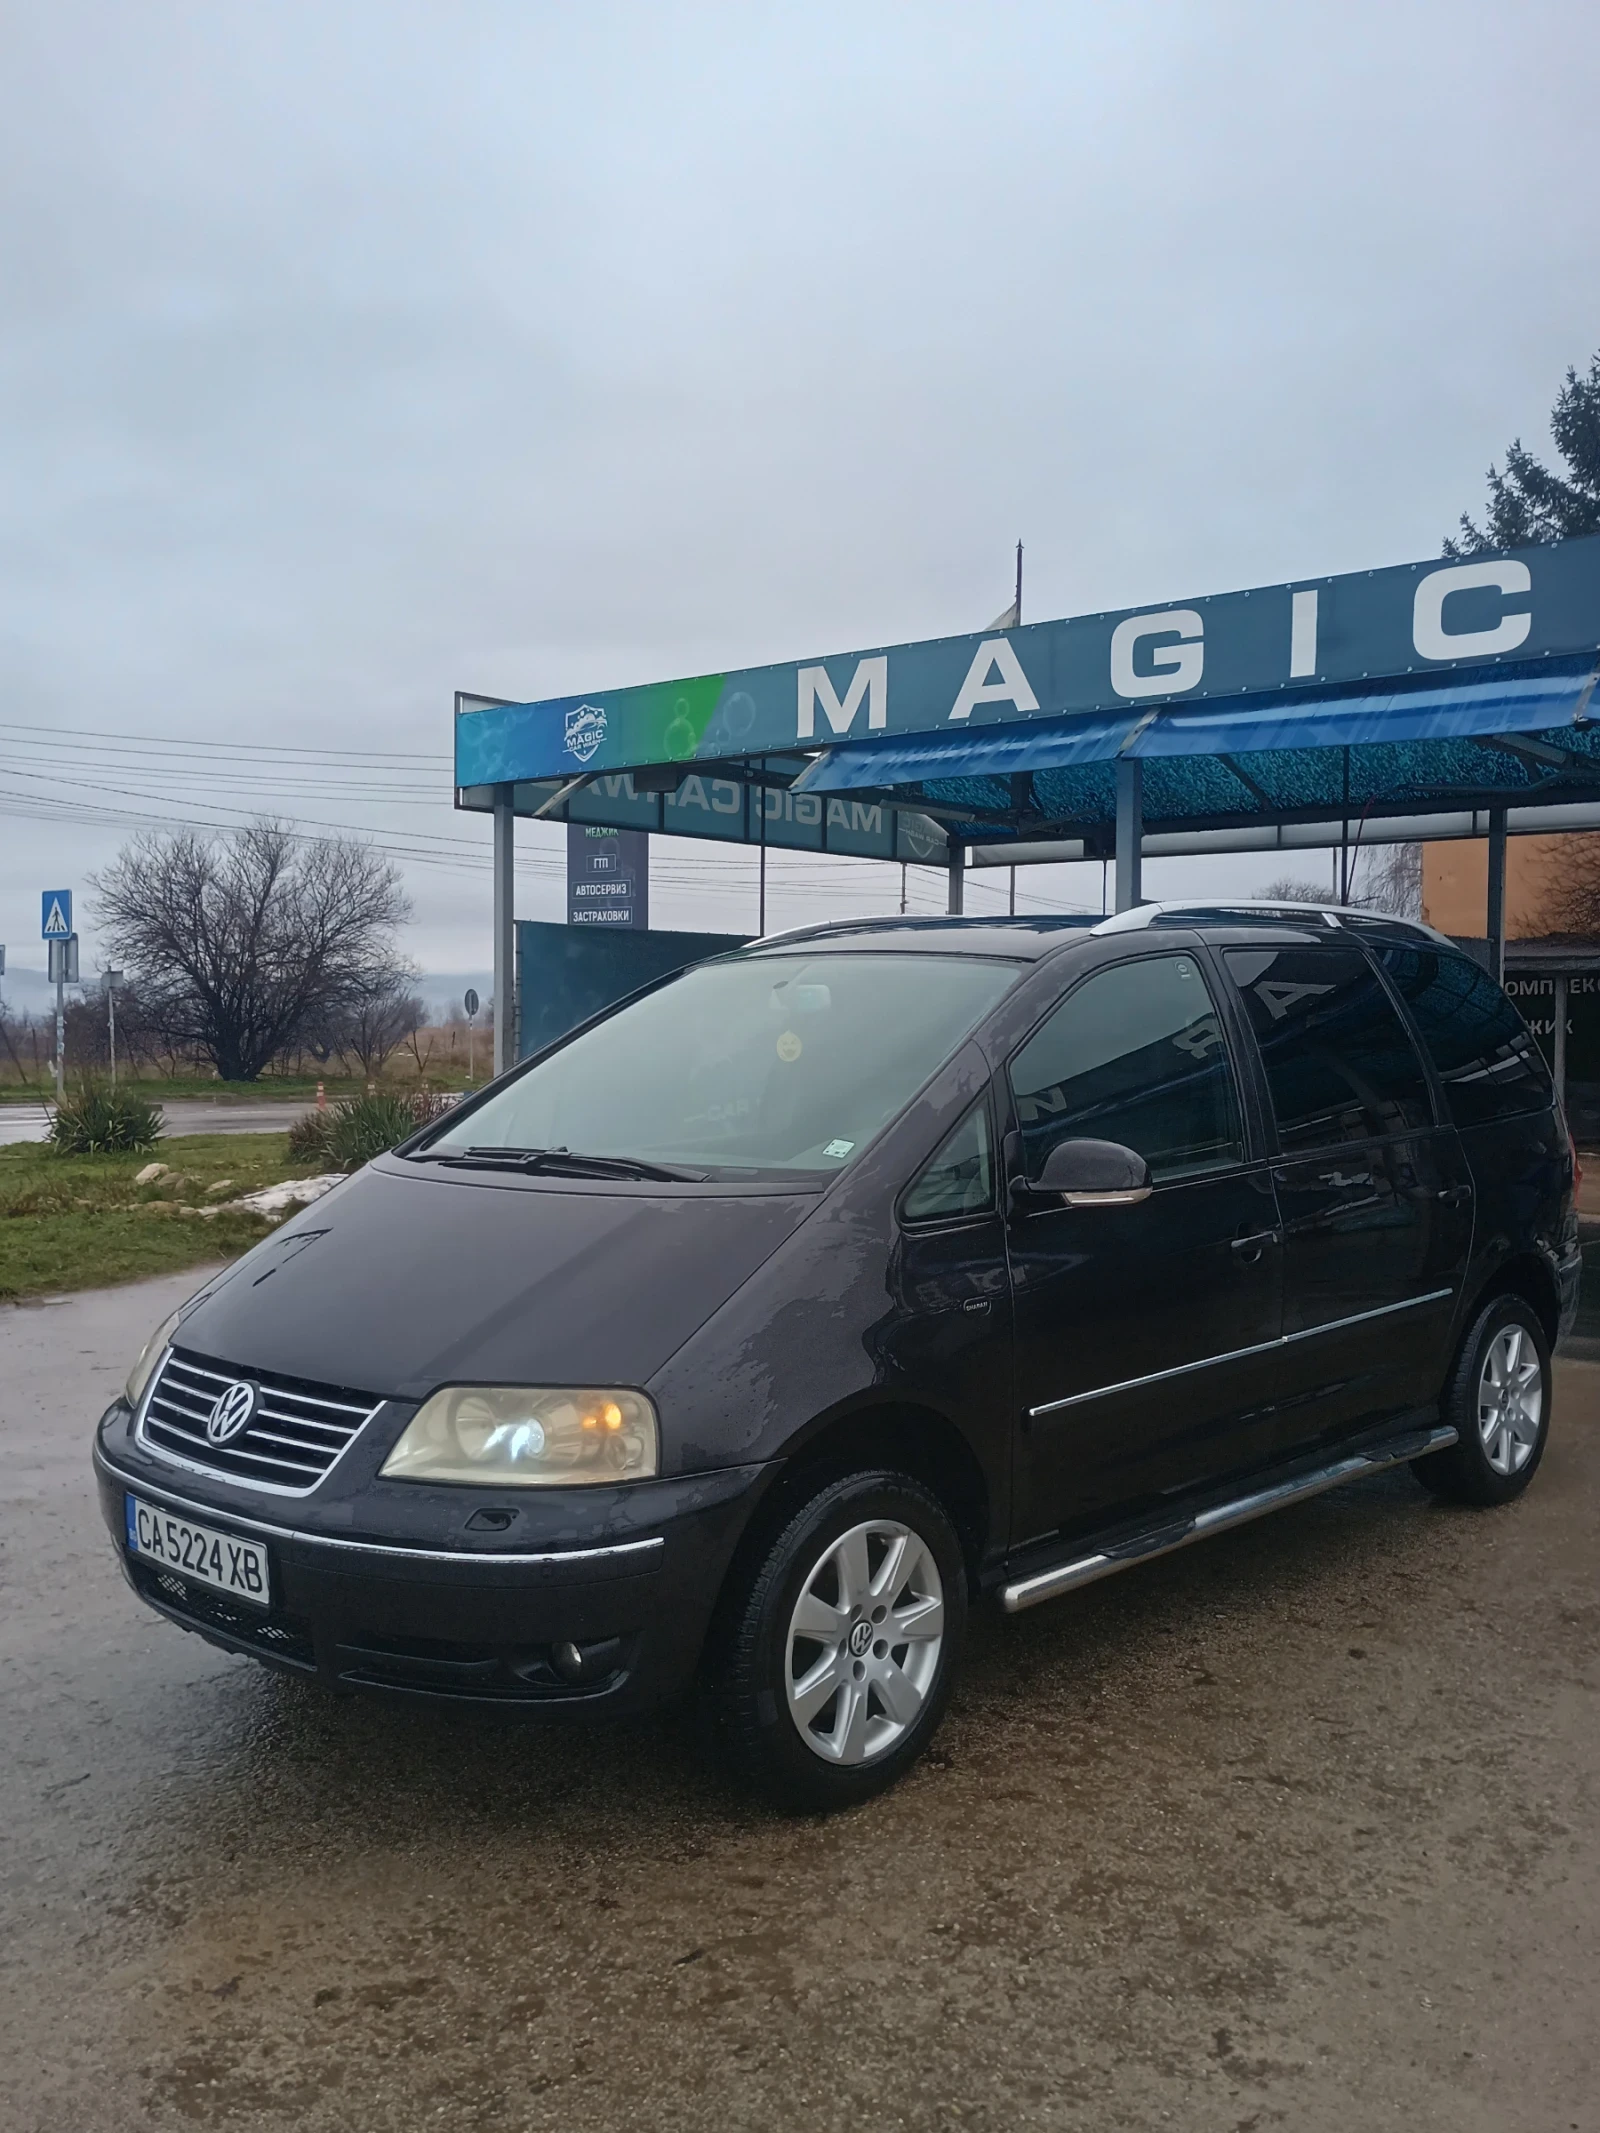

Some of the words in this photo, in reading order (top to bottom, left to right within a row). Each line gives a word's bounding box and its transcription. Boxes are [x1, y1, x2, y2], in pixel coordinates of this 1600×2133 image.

[797, 559, 1532, 738] MAGIC
[566, 729, 604, 748] MAGIC
[575, 883, 627, 896] АВТОСЕРВИЗ
[573, 910, 629, 923] ЗАСТРАХОВКИ
[1504, 978, 1600, 996] ОМПЕК
